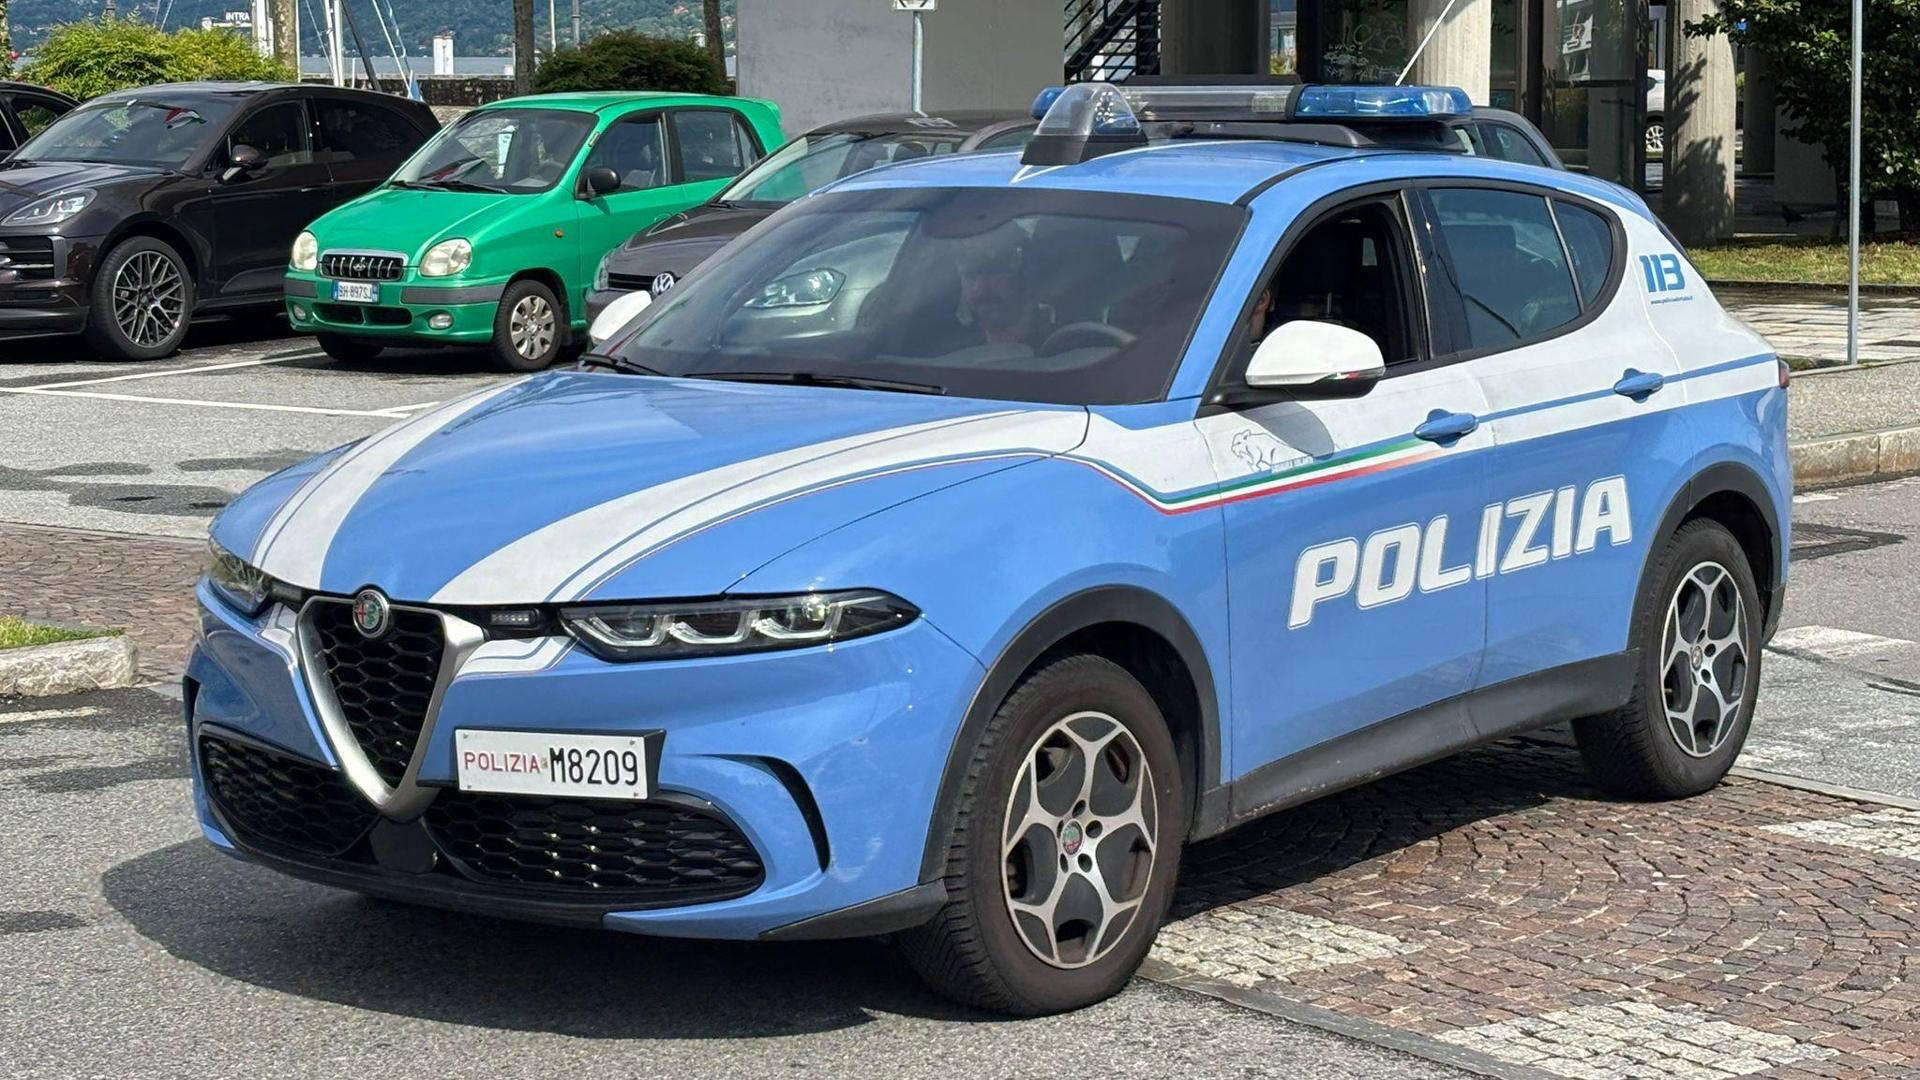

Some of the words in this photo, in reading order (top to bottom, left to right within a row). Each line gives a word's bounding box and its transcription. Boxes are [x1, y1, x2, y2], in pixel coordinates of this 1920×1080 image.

[225, 11, 250, 21] INTRA
[1638, 253, 1686, 293] 113
[1287, 473, 1633, 631] POLIZIA
[464, 751, 541, 774] POLIZIA
[549, 747, 639, 787] M8209
